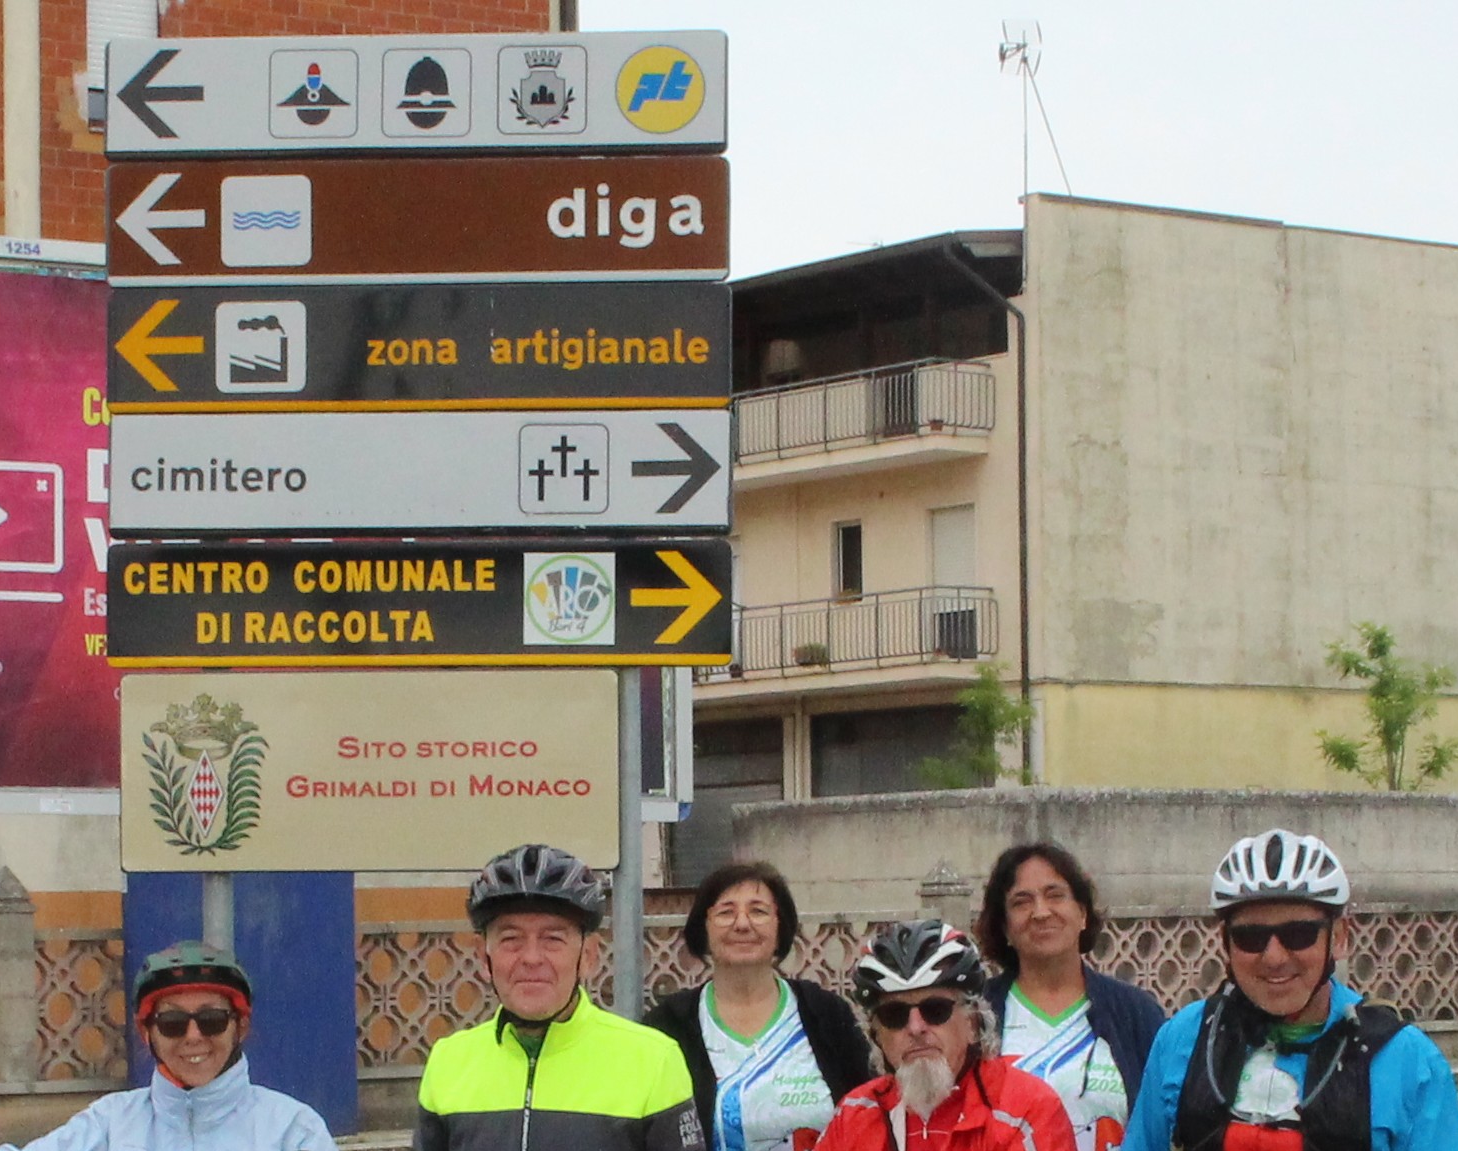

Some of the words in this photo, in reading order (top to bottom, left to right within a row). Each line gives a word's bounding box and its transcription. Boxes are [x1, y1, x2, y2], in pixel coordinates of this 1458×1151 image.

[546, 182, 705, 250] diga
[5, 241, 41, 256] 1254
[366, 336, 458, 366] zona
[490, 328, 710, 371] artigianale
[130, 457, 308, 494] cimitero
[123, 561, 269, 595] CENTRO
[293, 558, 496, 594] COMUNALE
[196, 612, 231, 645] DI
[243, 610, 435, 644] RACCOLTA
[771, 1073, 821, 1090] Maggio
[780, 1091, 820, 1107] 2025
